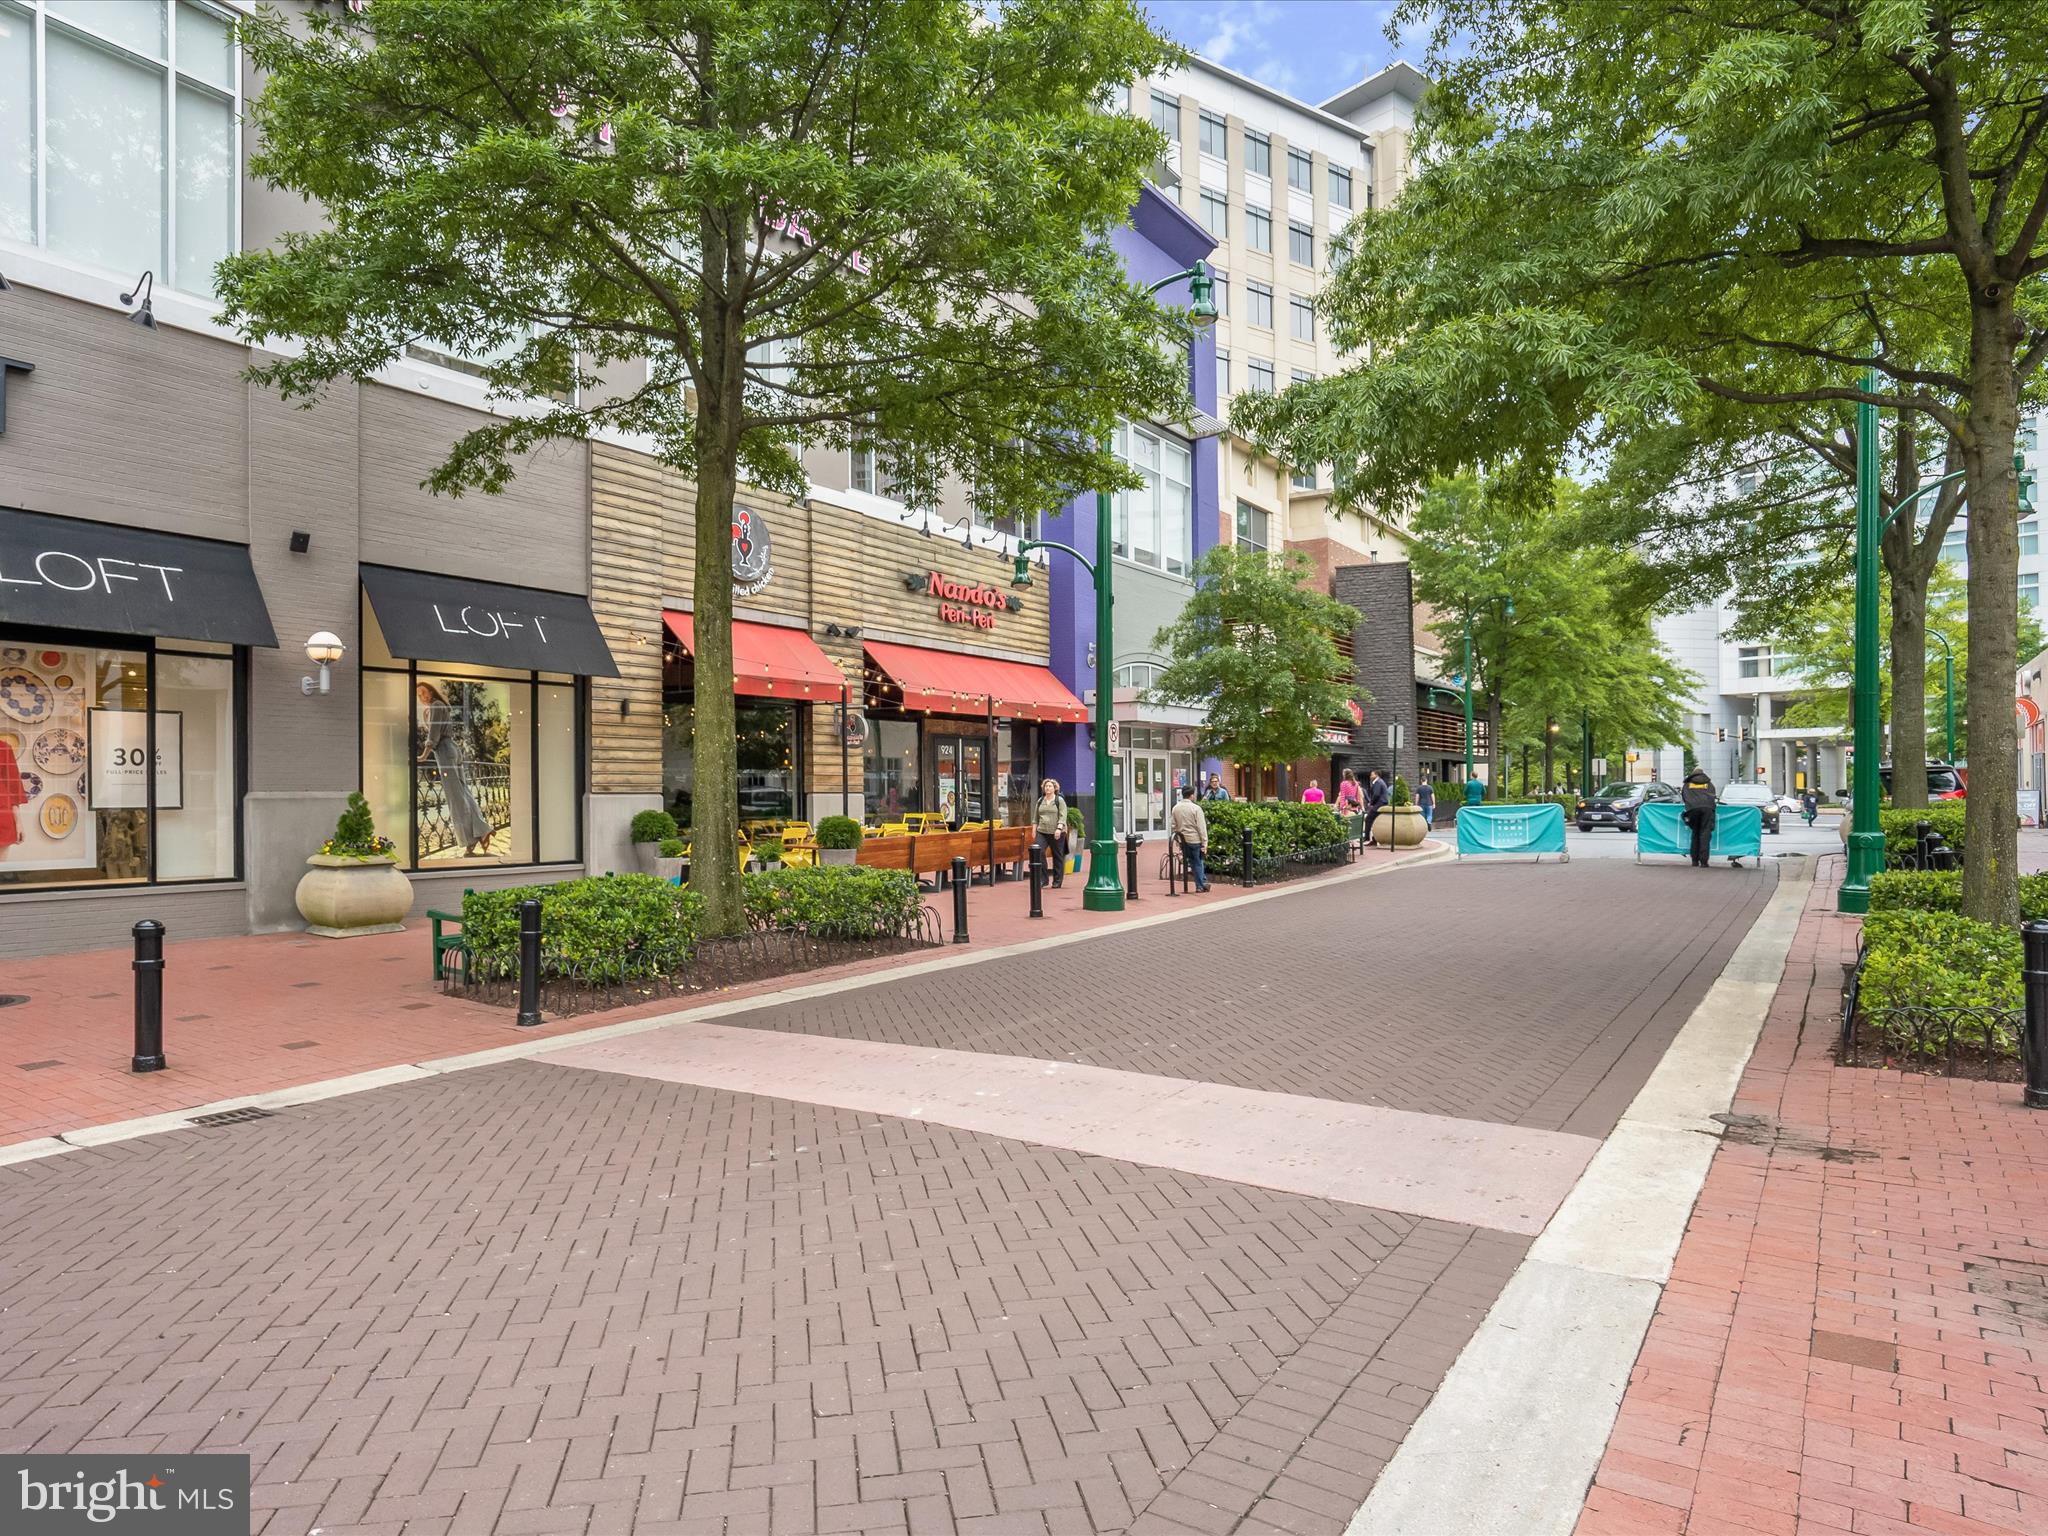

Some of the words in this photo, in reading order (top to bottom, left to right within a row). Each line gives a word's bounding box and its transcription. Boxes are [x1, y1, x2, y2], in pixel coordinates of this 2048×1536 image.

[732, 583, 750, 596] illed
[750, 567, 775, 594] chicken
[927, 570, 1007, 610] Nando's
[433, 604, 547, 643] LOFT
[941, 602, 997, 629] Peri-Peri
[940, 744, 954, 755] 924
